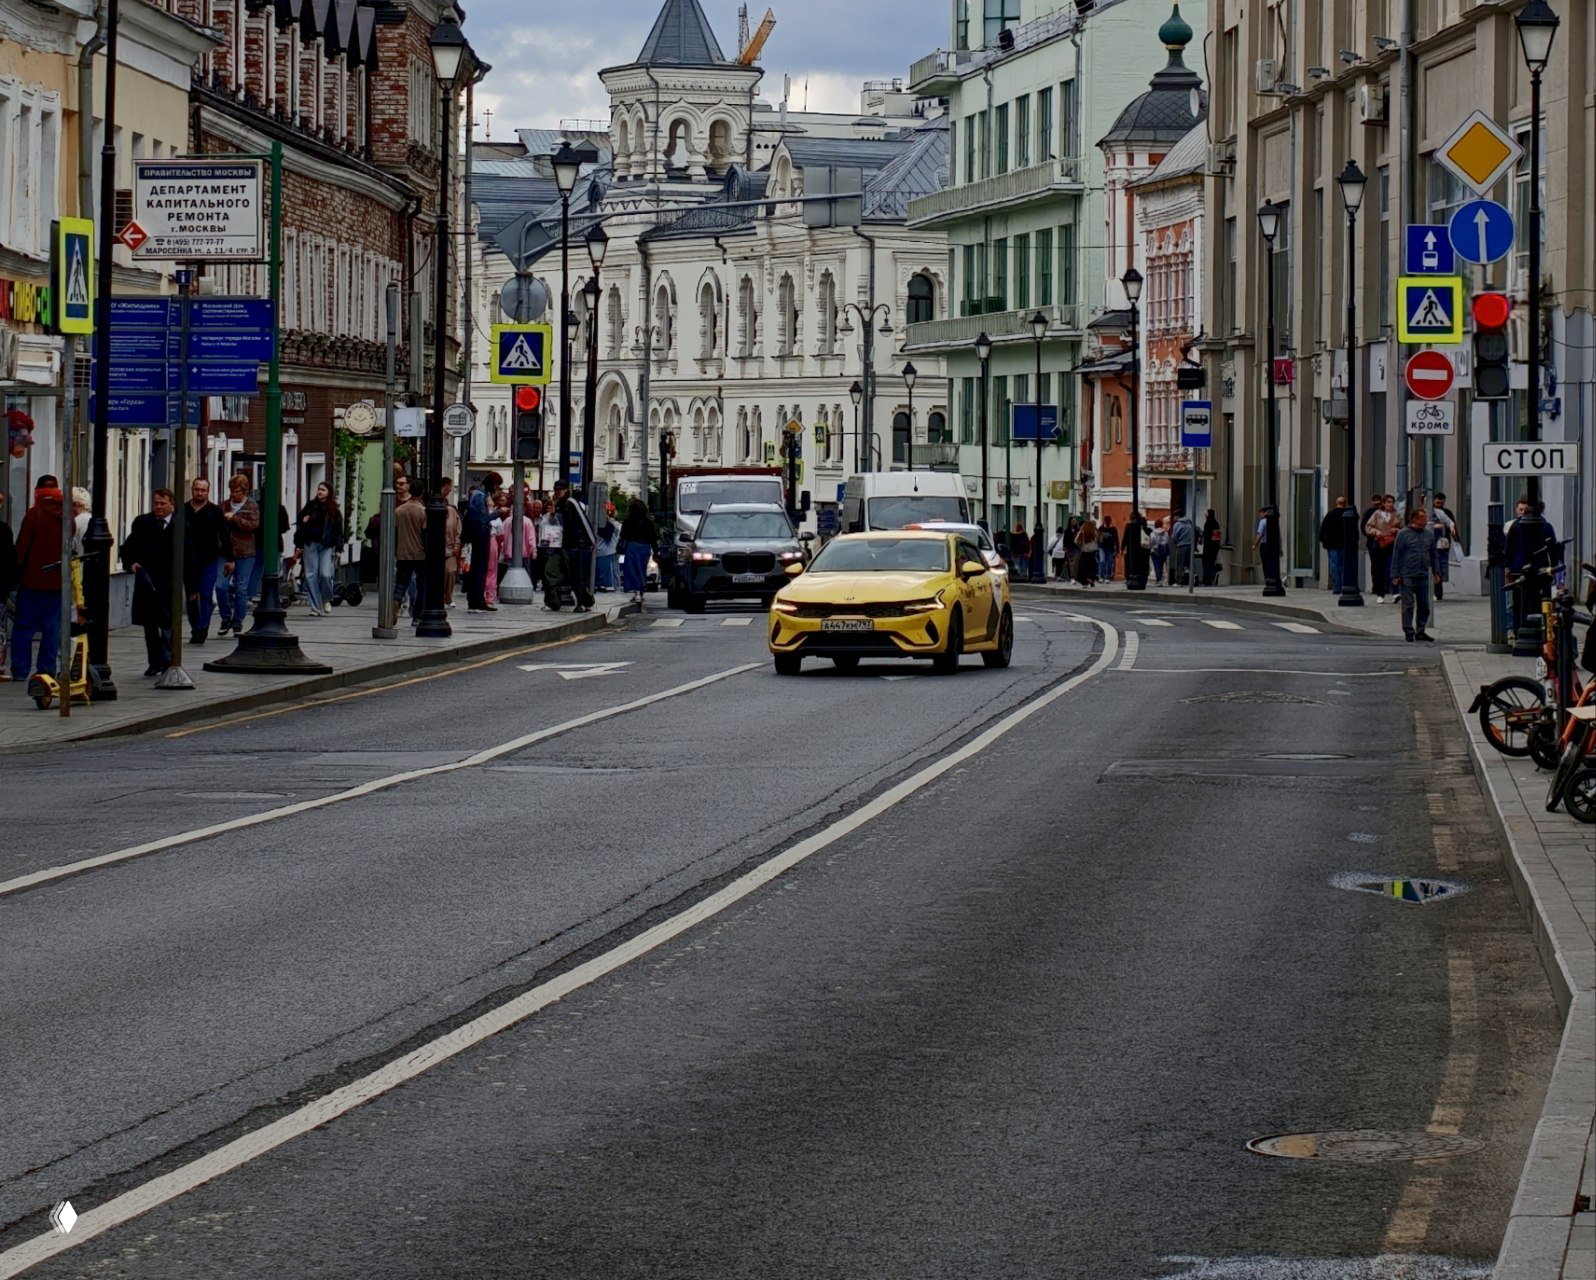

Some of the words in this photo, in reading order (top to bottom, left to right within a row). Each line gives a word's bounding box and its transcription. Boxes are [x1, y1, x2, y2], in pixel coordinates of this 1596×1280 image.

[144, 169, 213, 177] ПРАВИТЕЛЬСТВО
[149, 185, 247, 196] ДЕПАРТАМЕНТ
[146, 198, 250, 209] КАПИТАЛЬНОГО
[167, 212, 230, 221] РЕМОНТА
[173, 238, 190, 246] (495)
[192, 238, 225, 246] 777-77-77
[14, 281, 37, 322] ПИВО
[1411, 421, 1450, 432] кроме
[1497, 448, 1565, 470] СТОП
